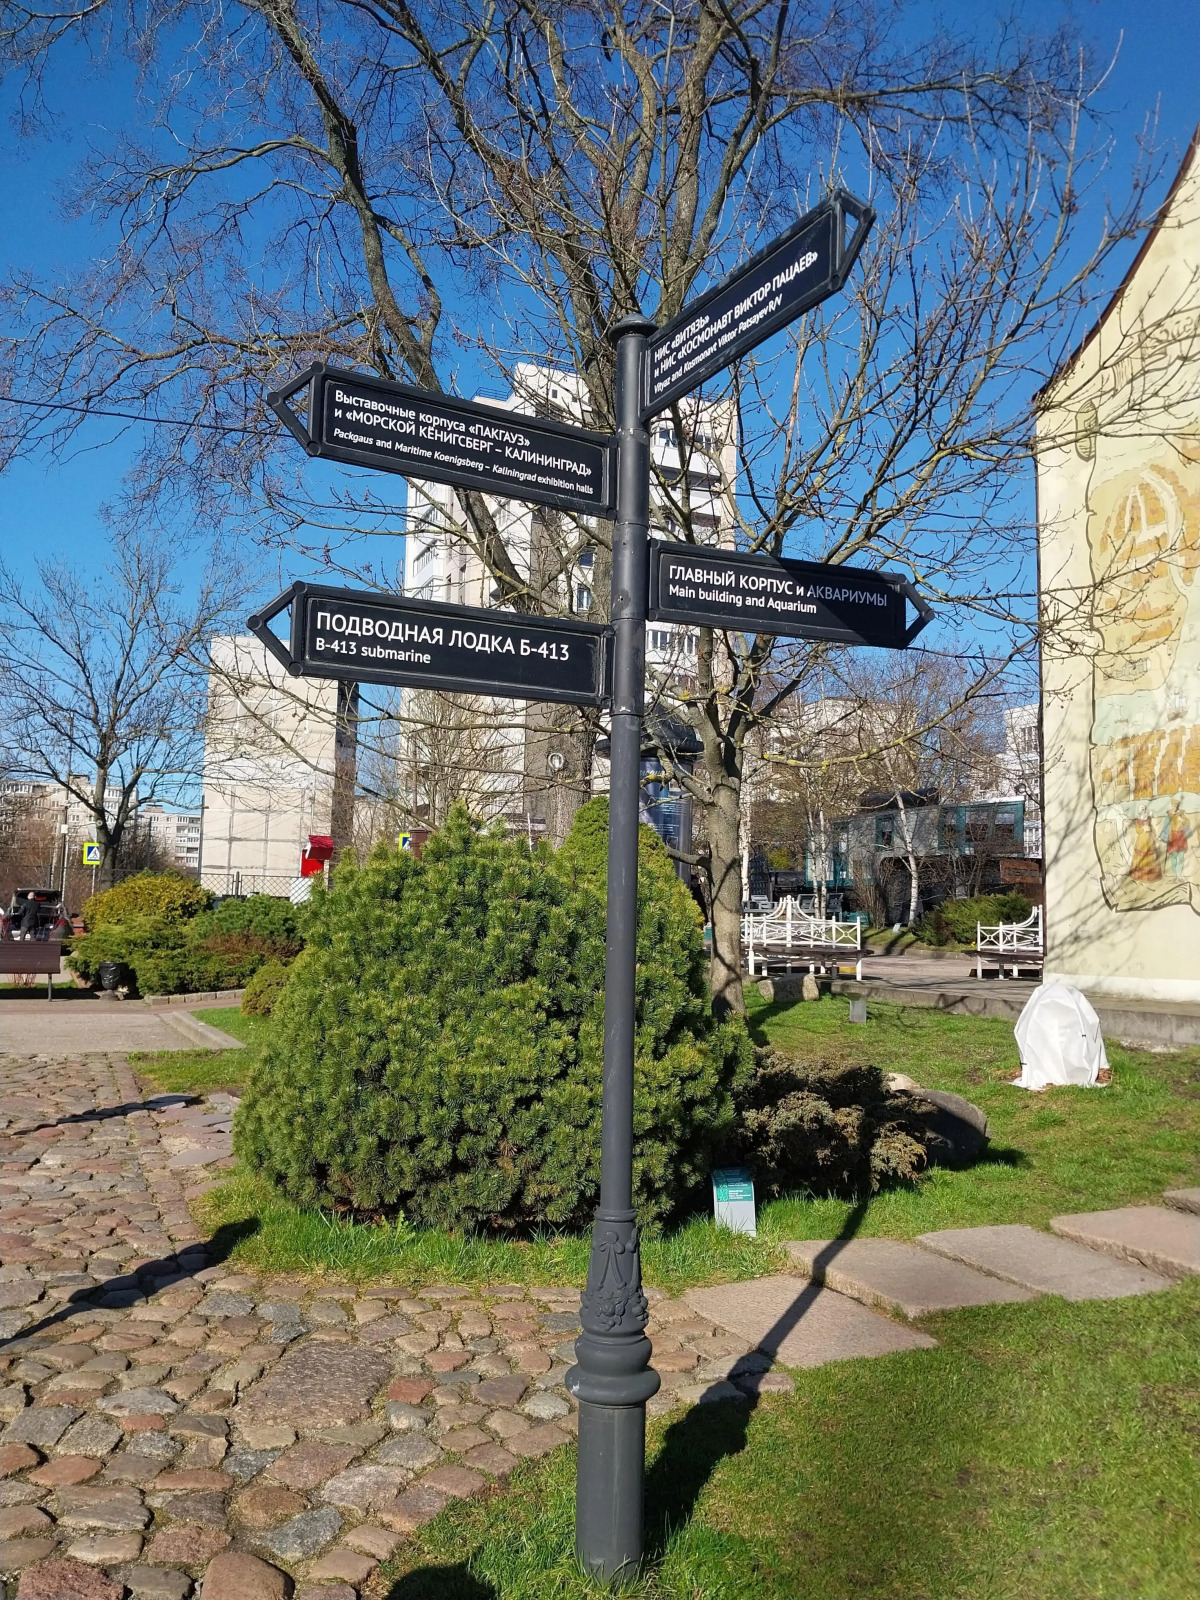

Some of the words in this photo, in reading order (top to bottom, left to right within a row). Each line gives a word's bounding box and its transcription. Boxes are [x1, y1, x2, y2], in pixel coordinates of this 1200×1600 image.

[654, 368, 660, 378] и
[660, 354, 677, 375] НИС
[677, 312, 732, 361] «КОСМОНАВТ
[734, 282, 771, 320] ВИКТОР
[772, 251, 819, 292] ПАЦАЕВ»
[654, 341, 670, 363] НИС
[671, 315, 710, 350] «ВИТЯЗЬ»
[654, 376, 671, 394] Vityaz
[671, 367, 683, 381] and
[683, 344, 718, 374] Kosmonavt
[718, 329, 737, 349] Viktor
[738, 309, 768, 334] Patsayev
[334, 408, 342, 419] и
[345, 410, 416, 435] «МОРСКОЙ
[419, 426, 494, 453] КЁНИГСБЕРГ
[505, 446, 592, 477] КАЛИНИНГРАД»
[335, 390, 416, 419] Выставочные
[419, 412, 466, 432] корпуса
[468, 424, 531, 447] «ПАКГАУЗ»
[333, 428, 374, 444] Packgaus
[375, 439, 392, 449] and
[394, 442, 432, 458] Maritime
[434, 452, 484, 471] Koenigsberg
[492, 464, 537, 481] Kaliningrad
[537, 476, 575, 491] exhibition
[576, 483, 594, 494] halls
[669, 565, 736, 588] ГЛАВНЫЙ
[740, 576, 794, 596] КОРПУС
[796, 586, 804, 597] и
[807, 584, 888, 607] АКВАРИУМЫ
[669, 584, 696, 599] Main
[698, 588, 743, 608] building
[745, 596, 766, 609] and
[767, 598, 817, 614] Aquarium
[315, 637, 357, 655] B-413
[361, 645, 431, 664] submarine
[316, 612, 443, 646] ПОДВОДНАЯ
[448, 630, 515, 655] ЛОДКА
[520, 639, 570, 661] Б-413
